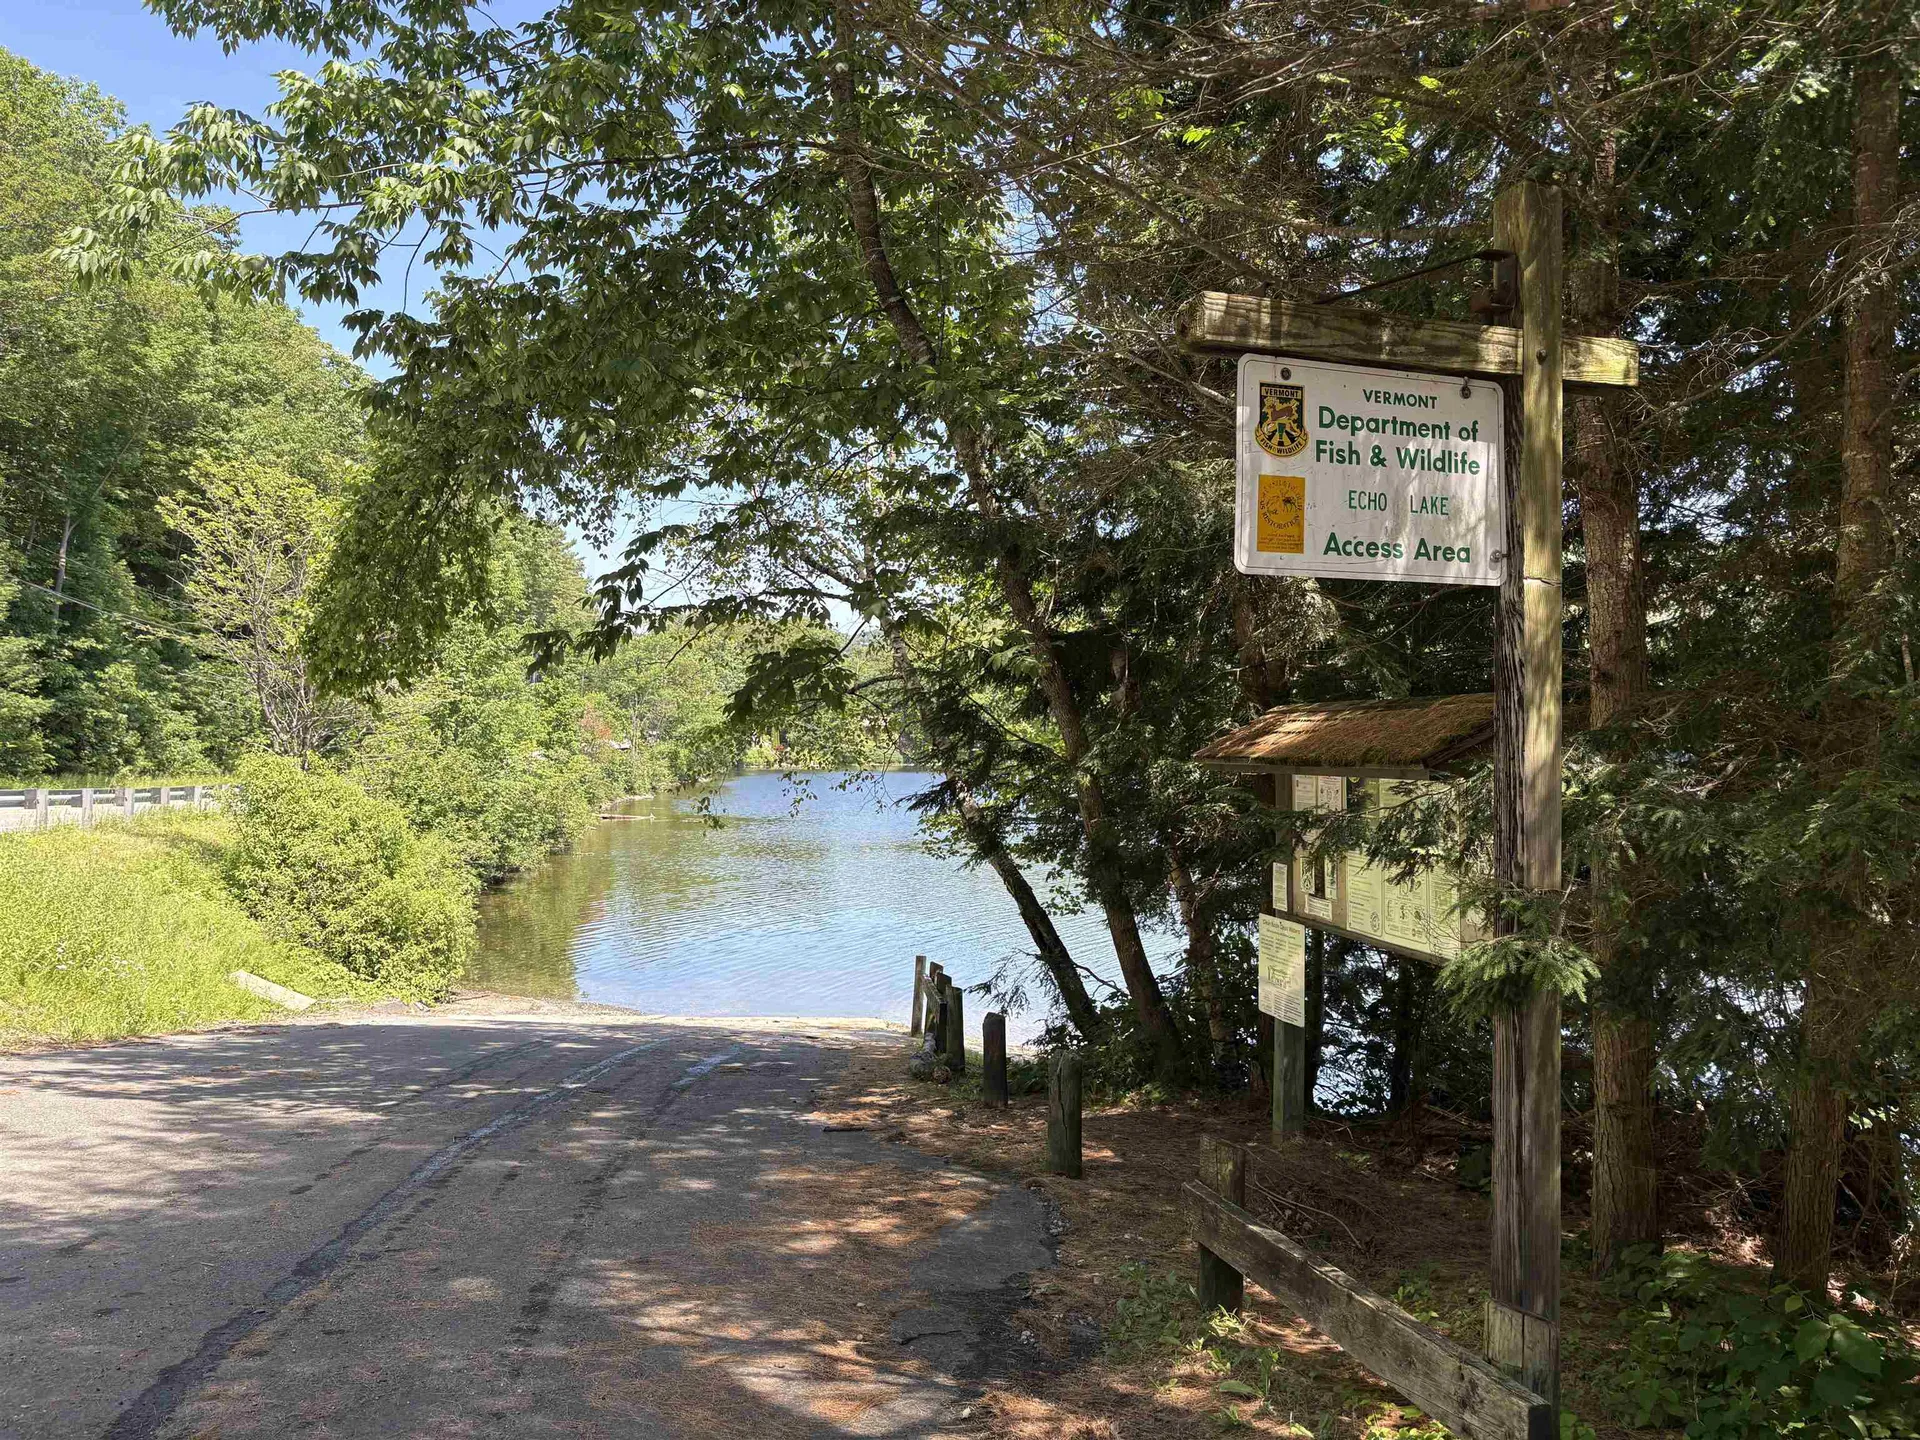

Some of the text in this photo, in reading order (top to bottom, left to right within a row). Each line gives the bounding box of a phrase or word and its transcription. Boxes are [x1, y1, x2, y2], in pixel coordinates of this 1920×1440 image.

[1264, 387, 1299, 398] VERMONT
[1363, 388, 1438, 409] VERMONT
[1318, 405, 1479, 443] Department of
[1260, 438, 1273, 450] FISH
[1276, 440, 1303, 455] WILDLIFE
[1315, 440, 1481, 475] Fish & Wildlife
[1348, 490, 1449, 516] ECHO LAKE
[1323, 532, 1404, 559] Access
[1414, 538, 1471, 563] Area
